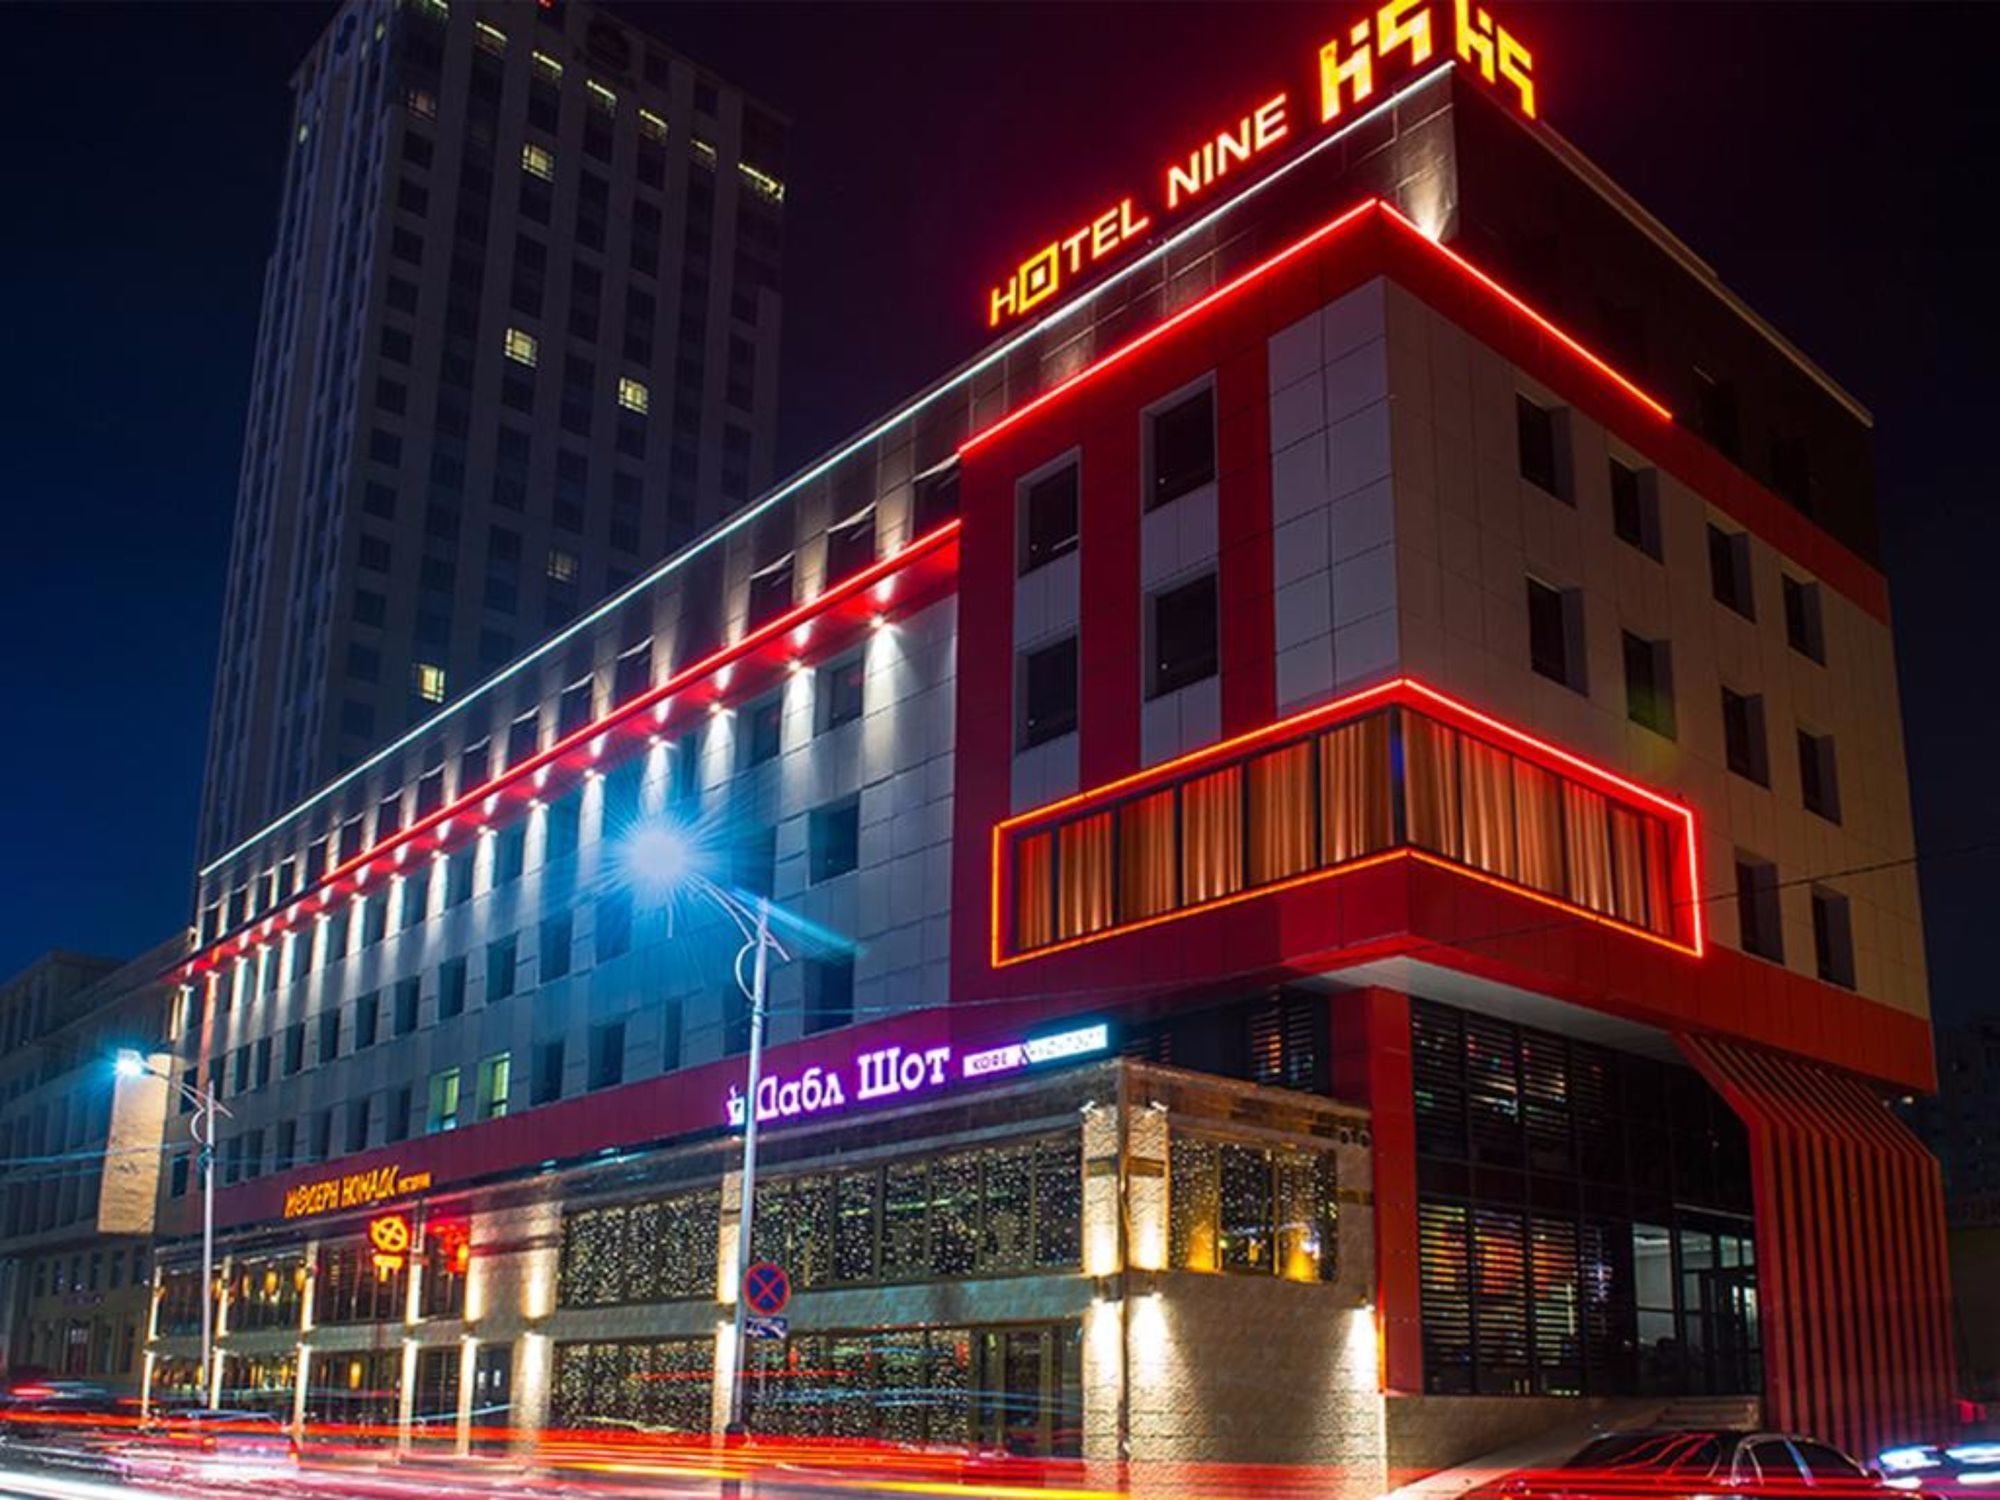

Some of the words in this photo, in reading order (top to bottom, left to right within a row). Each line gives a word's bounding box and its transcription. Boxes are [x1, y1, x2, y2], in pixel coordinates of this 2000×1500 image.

[990, 198, 1149, 326] HOTEL
[1168, 93, 1287, 208] NINE
[857, 1046, 950, 1100] Шот
